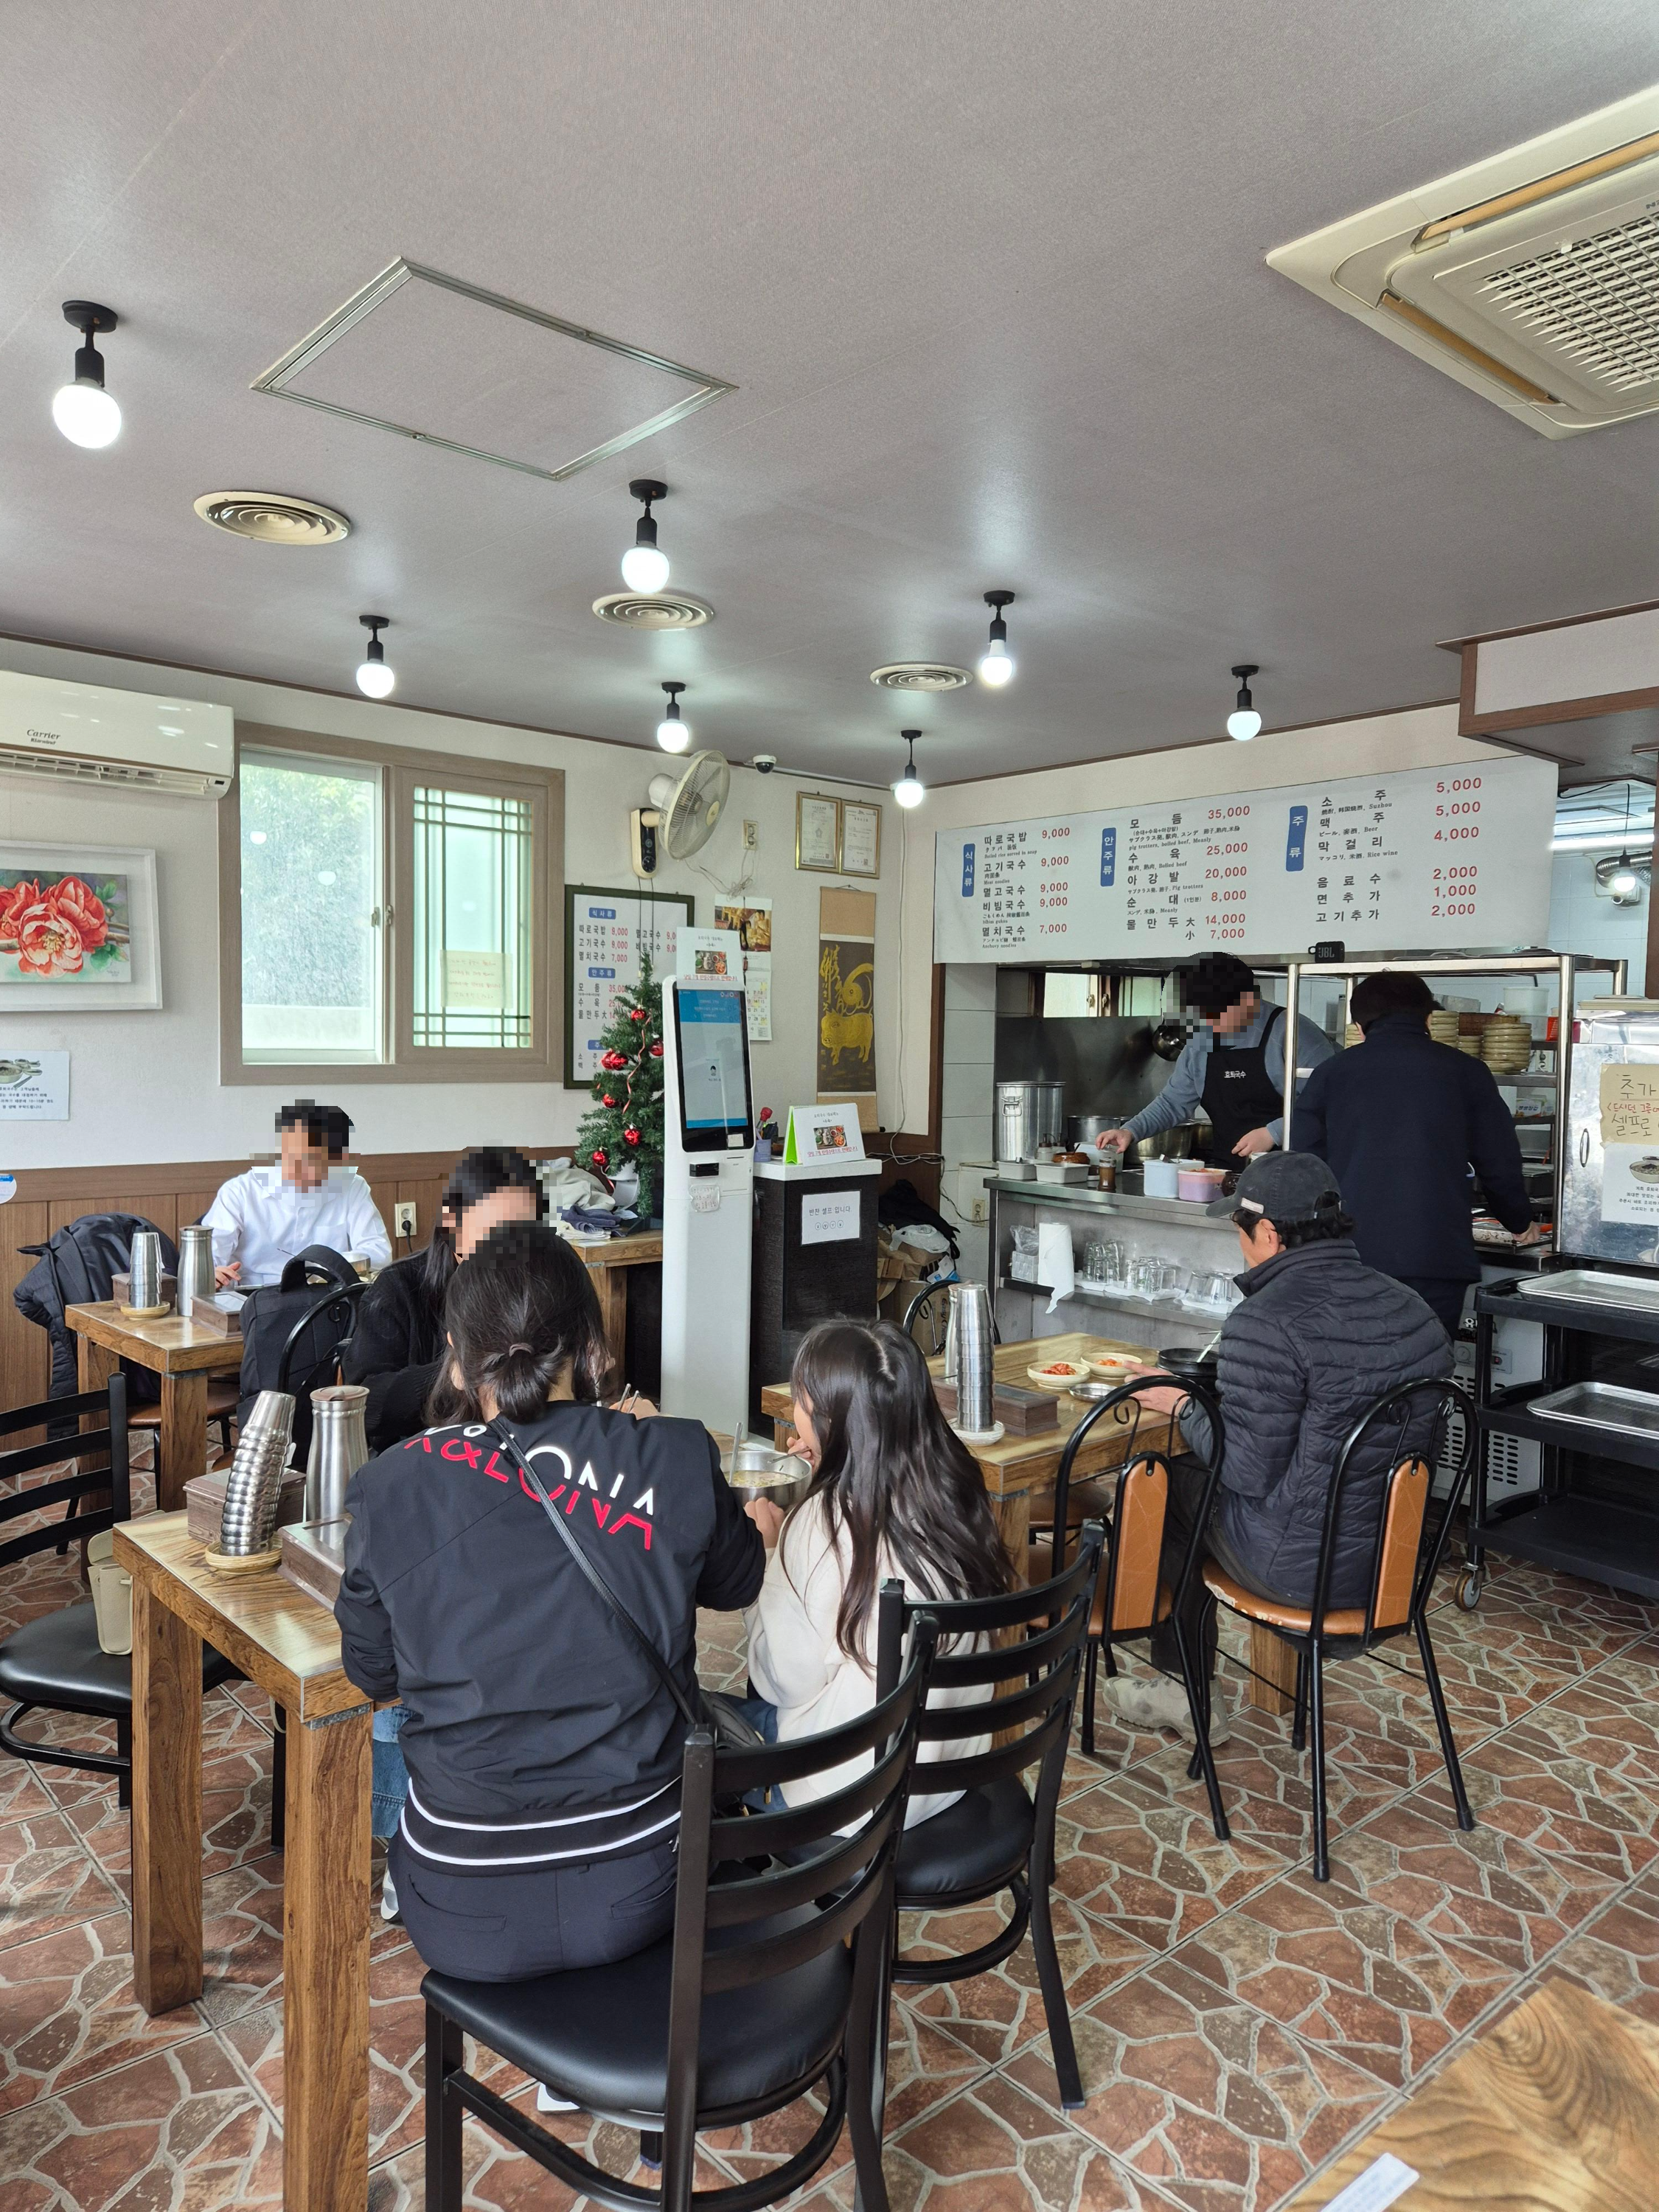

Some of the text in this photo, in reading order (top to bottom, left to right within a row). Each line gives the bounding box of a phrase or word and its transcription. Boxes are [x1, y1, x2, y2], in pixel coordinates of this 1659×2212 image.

[27, 728, 61, 740] Carrier
[1436, 777, 1481, 794] 5,000
[1208, 805, 1250, 819] 35,000
[1436, 801, 1481, 818] 5,000
[984, 827, 1070, 846] 따로국밥 9,000
[1434, 826, 1479, 842] 4,000
[1102, 836, 1114, 874] 안주류
[1206, 842, 1248, 855] 25,000
[984, 855, 1069, 872] 고기국수 9,000
[1205, 866, 1247, 879] 20,000
[1433, 866, 1478, 880] 2,000
[984, 882, 1068, 897] 멸고국수 9,000
[1211, 890, 1247, 902] 8,000
[1433, 884, 1476, 899] 1,000
[983, 897, 1068, 911] 비빔국수 9,000
[1431, 903, 1475, 918] 2,000
[1186, 917, 1195, 927] 大
[1206, 913, 1246, 925] 14,000
[611, 927, 628, 936] 9,000
[982, 923, 1067, 937] 멸치국수 7,000
[1185, 928, 1245, 940] 小 7,000
[579, 938, 605, 949] 고기국수
[611, 940, 628, 950] 9,000
[611, 953, 627, 963] 7,000
[1318, 947, 1335, 958] JBL
[1620, 1074, 1657, 1099] 추가
[1611, 1113, 1652, 1136] 셀프로
[822, 1207, 832, 1215] 셀프
